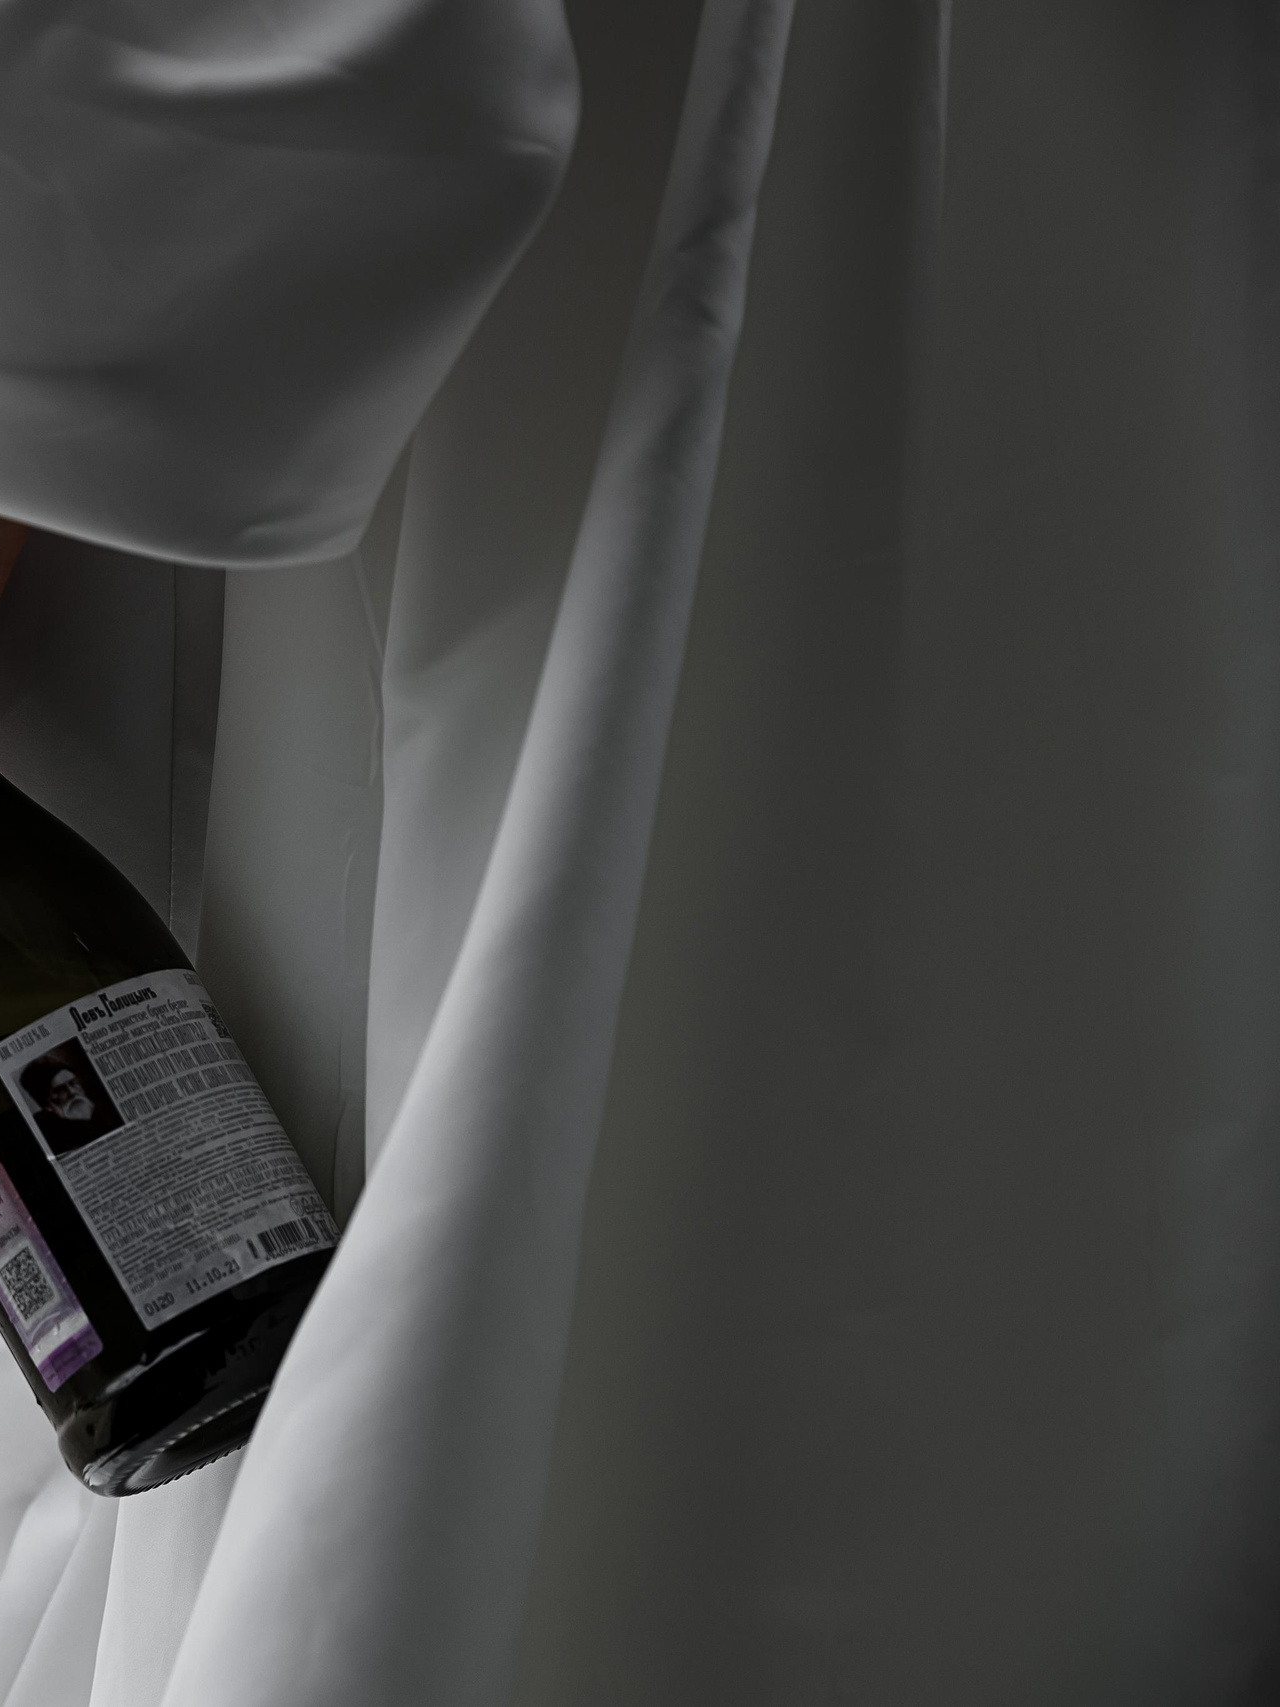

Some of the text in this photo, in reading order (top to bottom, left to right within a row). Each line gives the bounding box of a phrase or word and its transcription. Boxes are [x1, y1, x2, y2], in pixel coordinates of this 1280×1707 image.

[69, 987, 157, 1031] Левъ Голицынъ
[81, 1027, 108, 1045] Вино
[108, 1010, 148, 1033] игристое
[146, 1004, 170, 1021] брют
[143, 1259, 240, 1316] 0120 11.10.21
